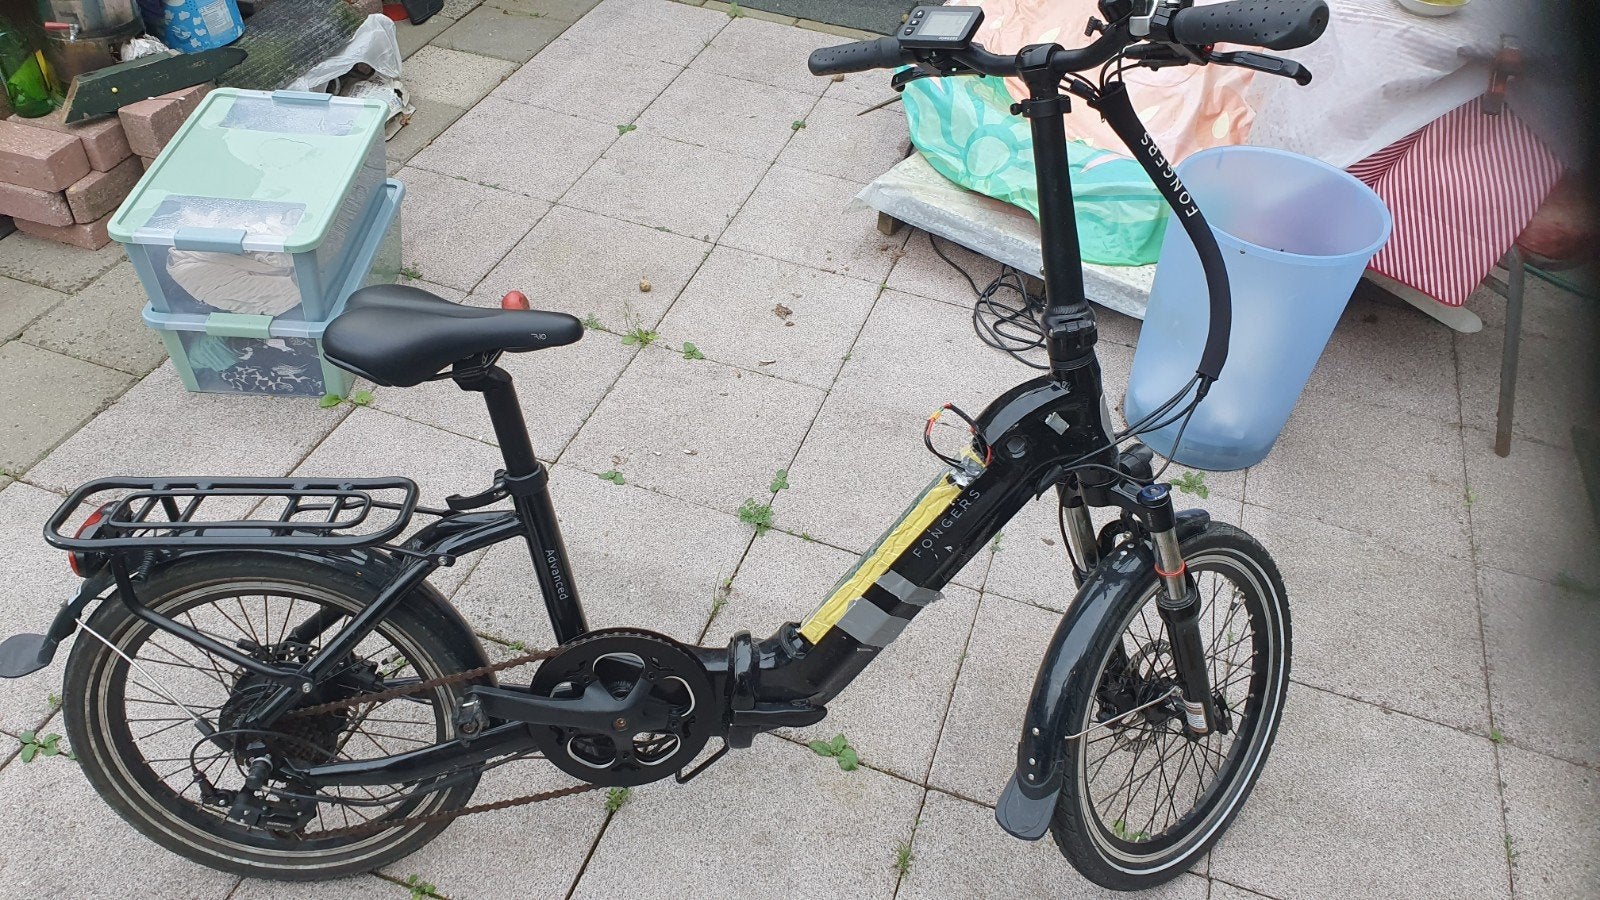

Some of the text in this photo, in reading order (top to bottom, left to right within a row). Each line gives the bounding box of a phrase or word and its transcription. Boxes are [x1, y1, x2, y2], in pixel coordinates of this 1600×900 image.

[1140, 131, 1199, 217] FONGERS
[912, 489, 980, 558] FONGERS
[545, 549, 569, 600] Advanced
